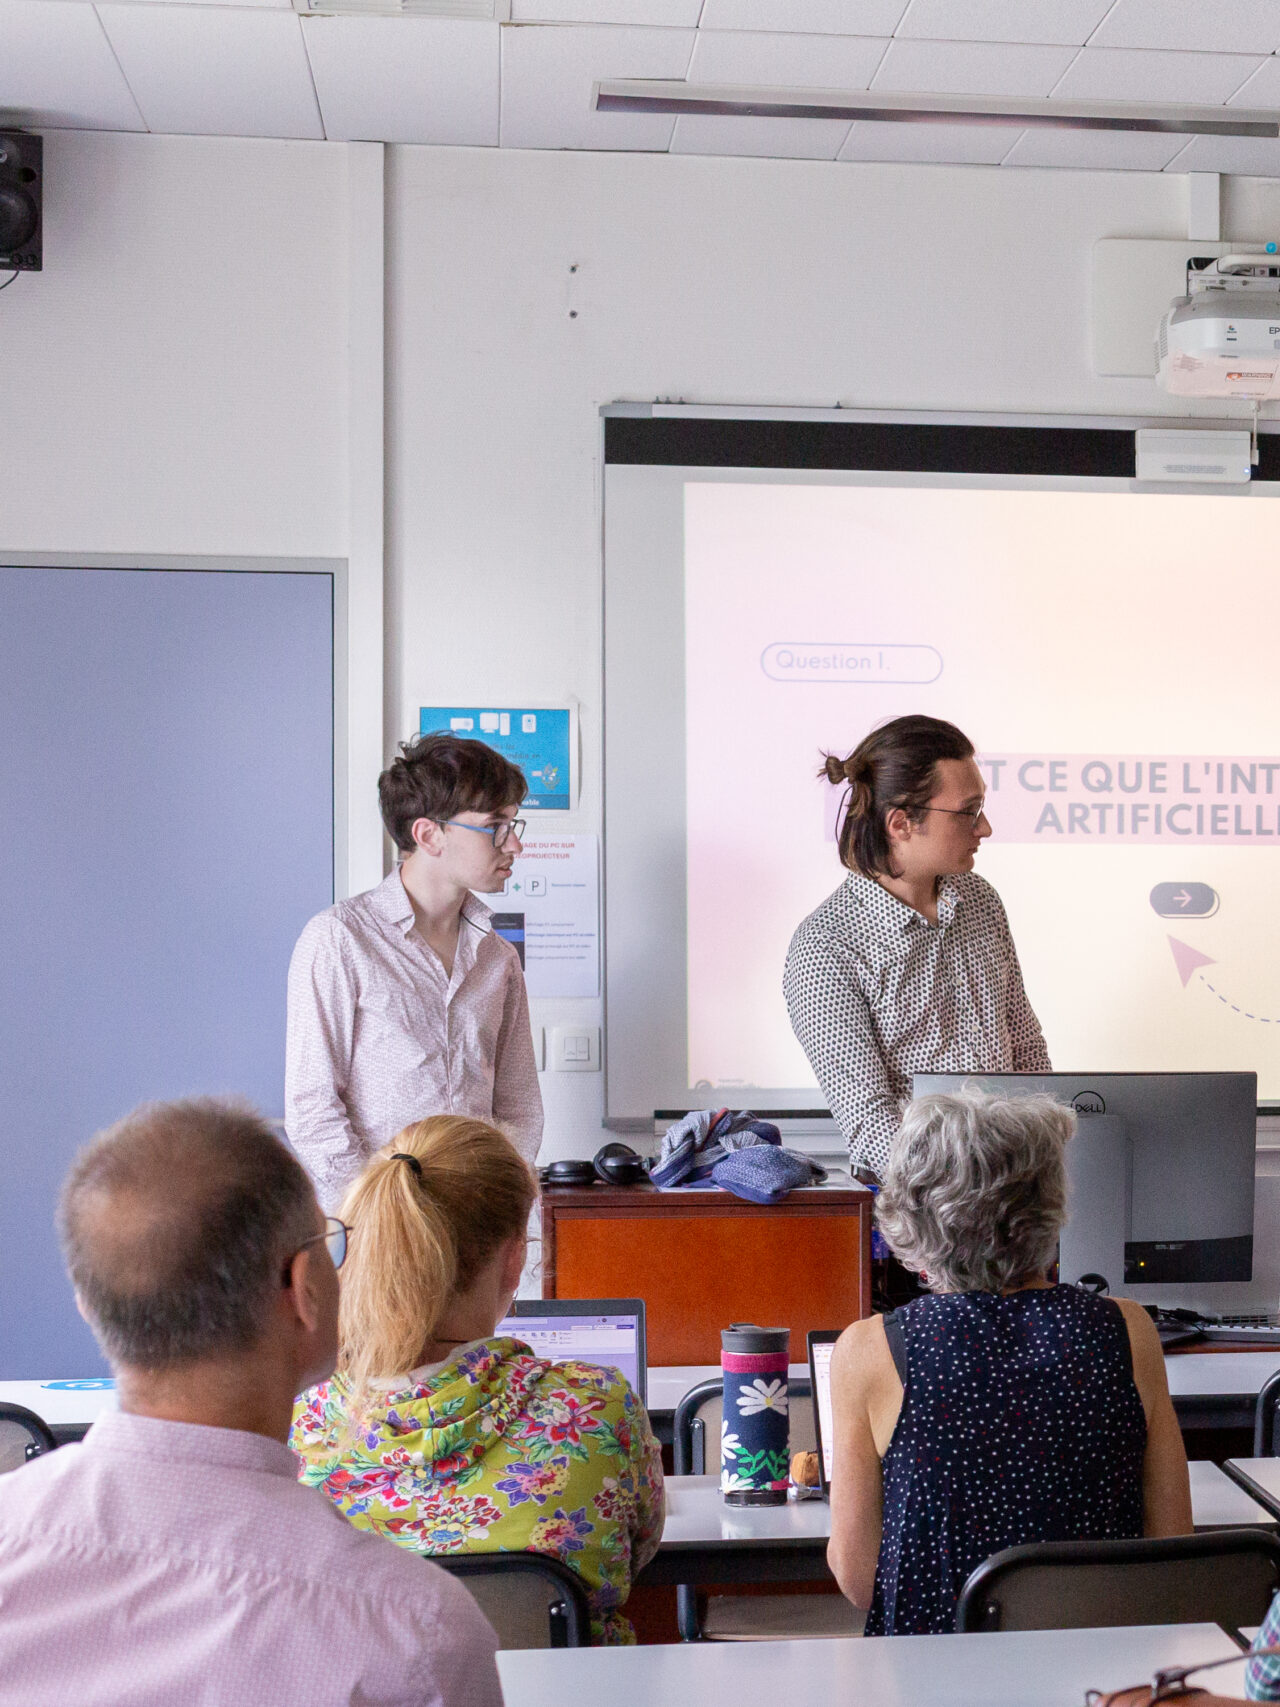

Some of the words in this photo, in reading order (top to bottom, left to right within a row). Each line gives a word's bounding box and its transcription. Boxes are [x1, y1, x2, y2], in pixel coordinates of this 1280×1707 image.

[776, 649, 872, 669] Question
[978, 759, 1007, 792] T
[1017, 759, 1068, 793] CE
[1081, 760, 1168, 794] QUE
[531, 880, 540, 892] P
[1075, 1103, 1102, 1113] DELL
